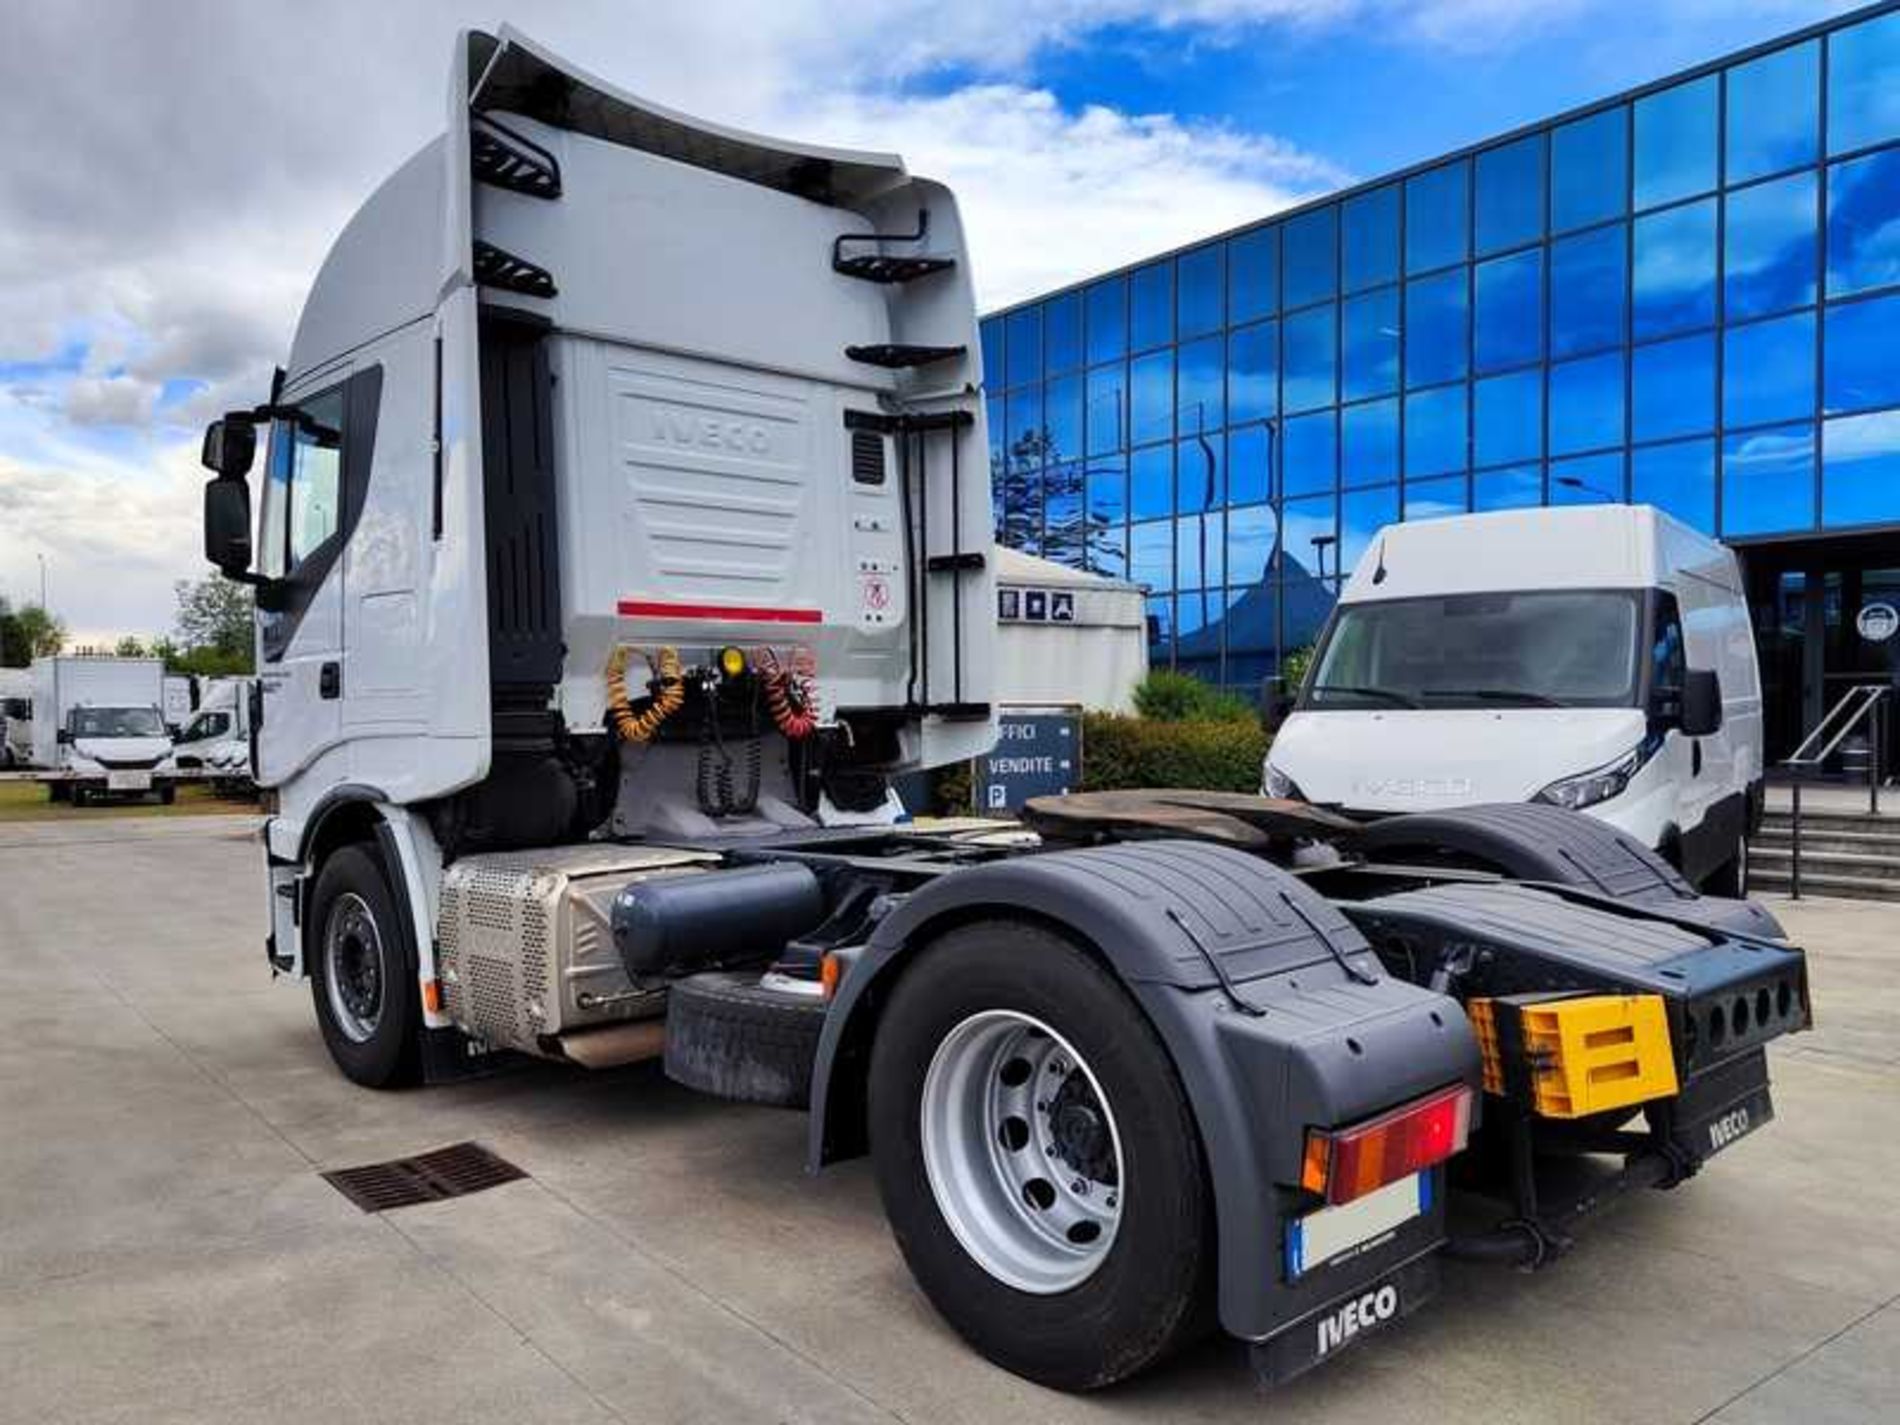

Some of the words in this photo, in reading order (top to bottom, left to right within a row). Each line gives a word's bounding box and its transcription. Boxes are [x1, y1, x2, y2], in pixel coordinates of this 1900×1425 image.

[652, 408, 770, 454] IVECO
[998, 724, 1037, 740] FFICI
[989, 757, 1053, 774] VENDITE
[1709, 1107, 1749, 1150] IVECO
[1317, 1284, 1398, 1355] IVECO
